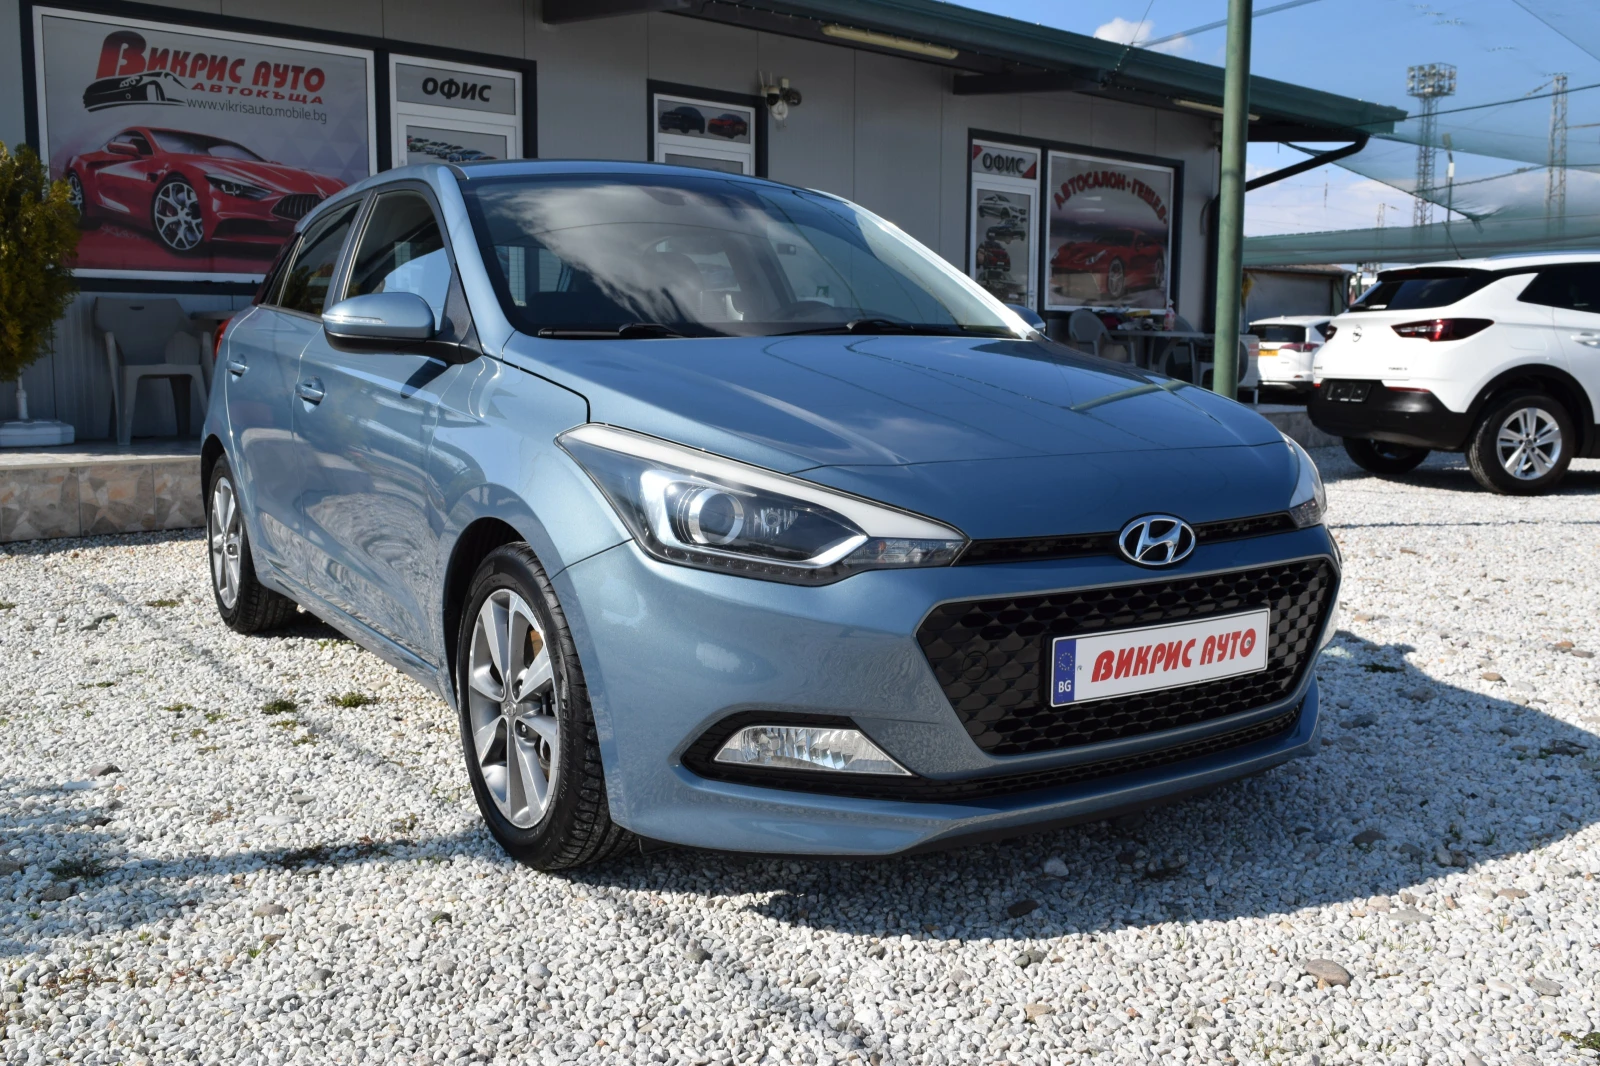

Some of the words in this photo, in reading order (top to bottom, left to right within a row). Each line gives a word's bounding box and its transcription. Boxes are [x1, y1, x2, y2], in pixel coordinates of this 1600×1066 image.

[252, 61, 325, 92] АУТО
[191, 82, 324, 105] АВТОКЪЩА
[422, 77, 491, 102] ОФИС
[186, 98, 327, 124] www.vikrisauto.mobile.bg
[981, 152, 1025, 174] ОФИС
[1053, 171, 1126, 210] АВТОСАЛОН
[1091, 638, 1196, 682] ВИКРИС
[1199, 628, 1257, 666] АУТО
[1058, 679, 1072, 692] BG
